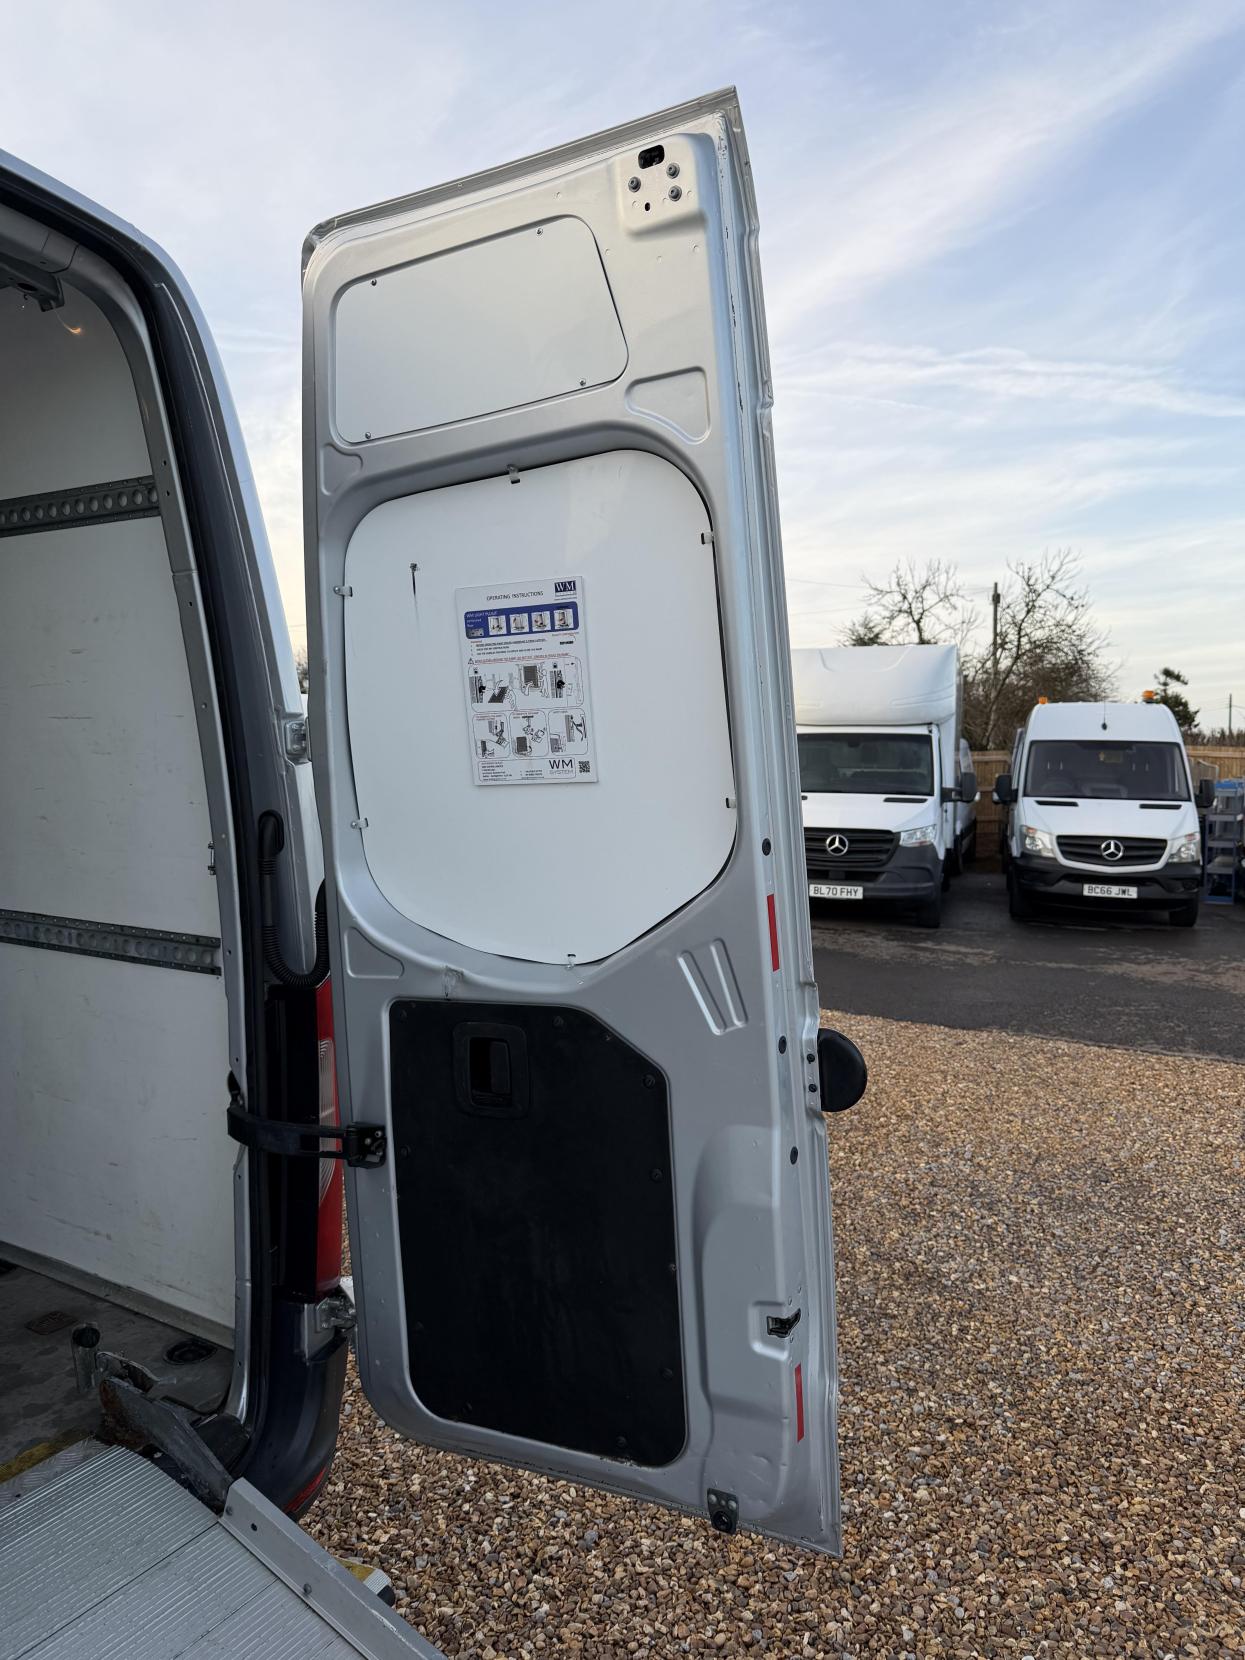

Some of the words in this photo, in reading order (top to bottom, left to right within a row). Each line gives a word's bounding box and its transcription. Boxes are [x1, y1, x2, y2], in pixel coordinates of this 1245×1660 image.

[555, 581, 575, 592] WM
[487, 593, 510, 601] OPERATING
[549, 759, 573, 769] WM
[813, 886, 838, 896] BL70
[840, 887, 859, 897] FHY
[1087, 885, 1112, 895] BC66
[1114, 887, 1133, 896] JWL
